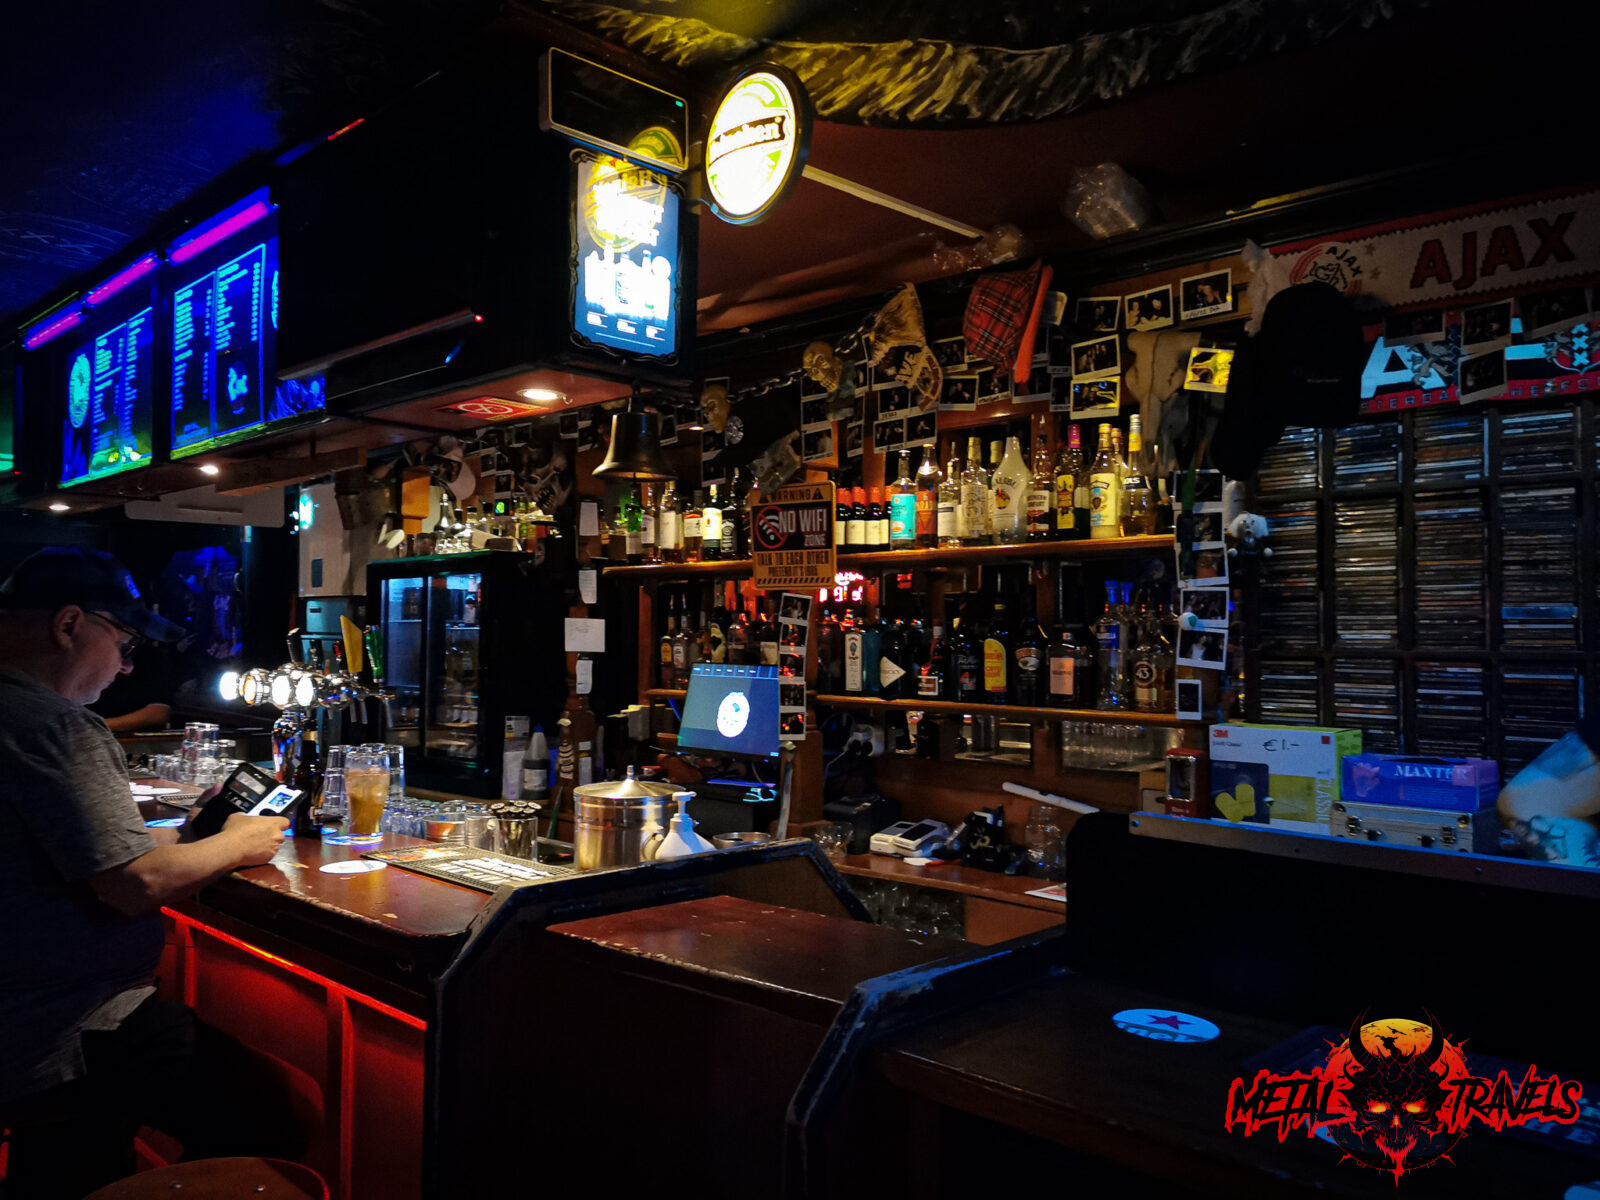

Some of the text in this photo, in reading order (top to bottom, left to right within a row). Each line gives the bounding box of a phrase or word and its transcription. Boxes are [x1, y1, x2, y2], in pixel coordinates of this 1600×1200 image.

[1410, 212, 1576, 290] AJAX
[1326, 246, 1363, 278] AJAX
[771, 488, 811, 502] ARNING
[779, 509, 827, 534] NO WIFI
[804, 534, 826, 547] ZONE
[1213, 729, 1229, 738] 3M
[1394, 764, 1468, 780] MAXTER
